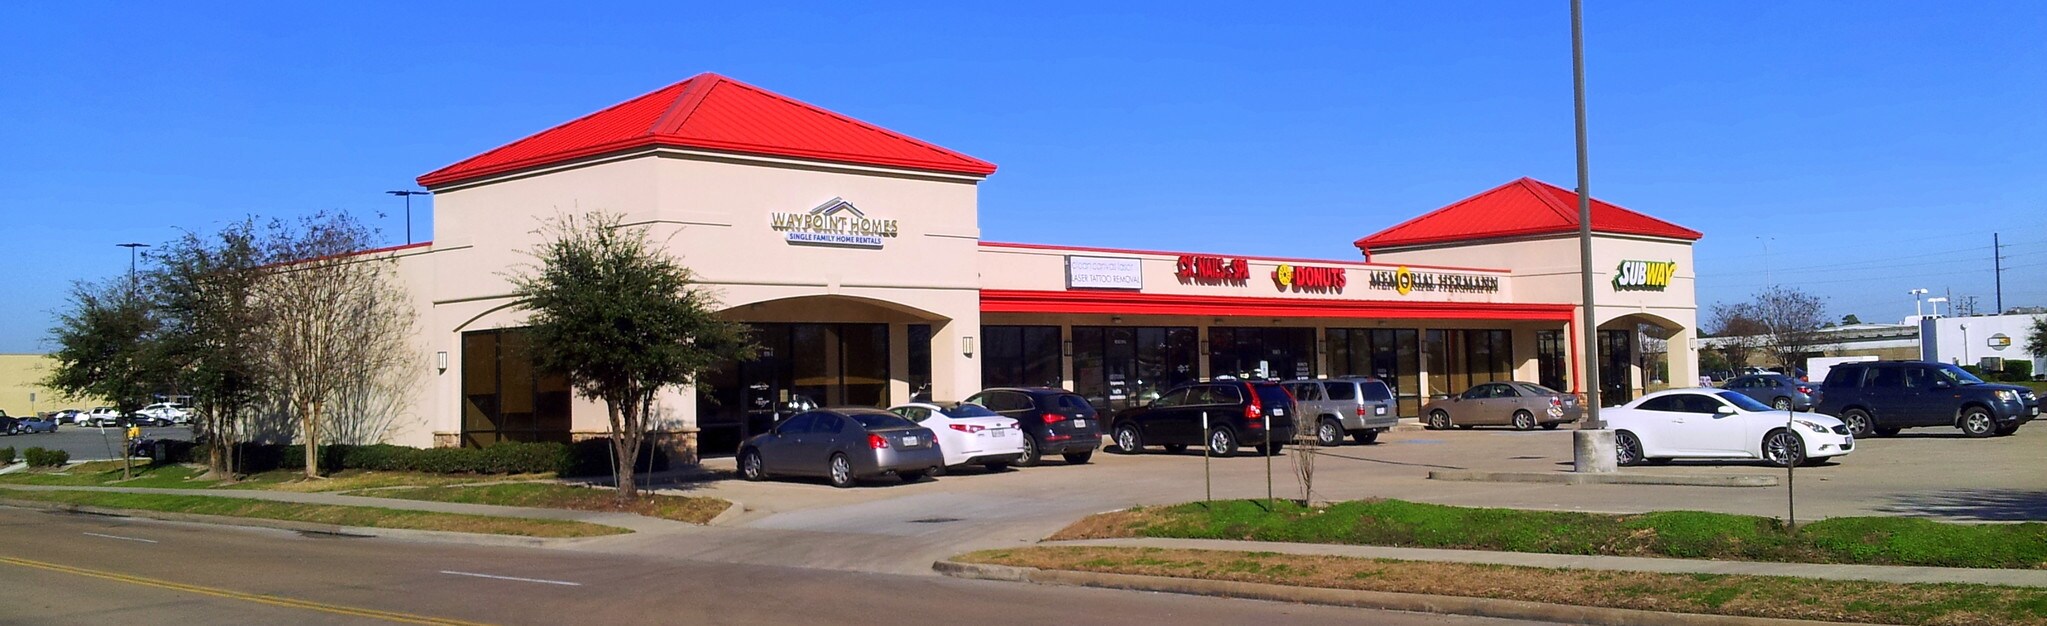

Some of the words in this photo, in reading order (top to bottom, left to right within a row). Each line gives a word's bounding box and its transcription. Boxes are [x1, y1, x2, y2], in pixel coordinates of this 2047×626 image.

[771, 211, 847, 232] WAYPOINT
[850, 217, 898, 234] HOMES
[789, 233, 812, 241] SINGLE
[813, 234, 835, 242] FAMILY
[836, 235, 855, 243] HOME
[855, 236, 882, 245] RENTALS
[1072, 273, 1089, 283] LASER
[1089, 274, 1112, 284] TATTOO
[1113, 275, 1140, 285] REMOVAL
[1197, 257, 1225, 279] NAILS
[1232, 259, 1250, 279] SPA
[1295, 266, 1347, 288] DONUTS
[1618, 260, 1677, 287] SUBWAY
[1370, 267, 1433, 292] MEMORIAL
[1438, 273, 1499, 292] HERMANN
